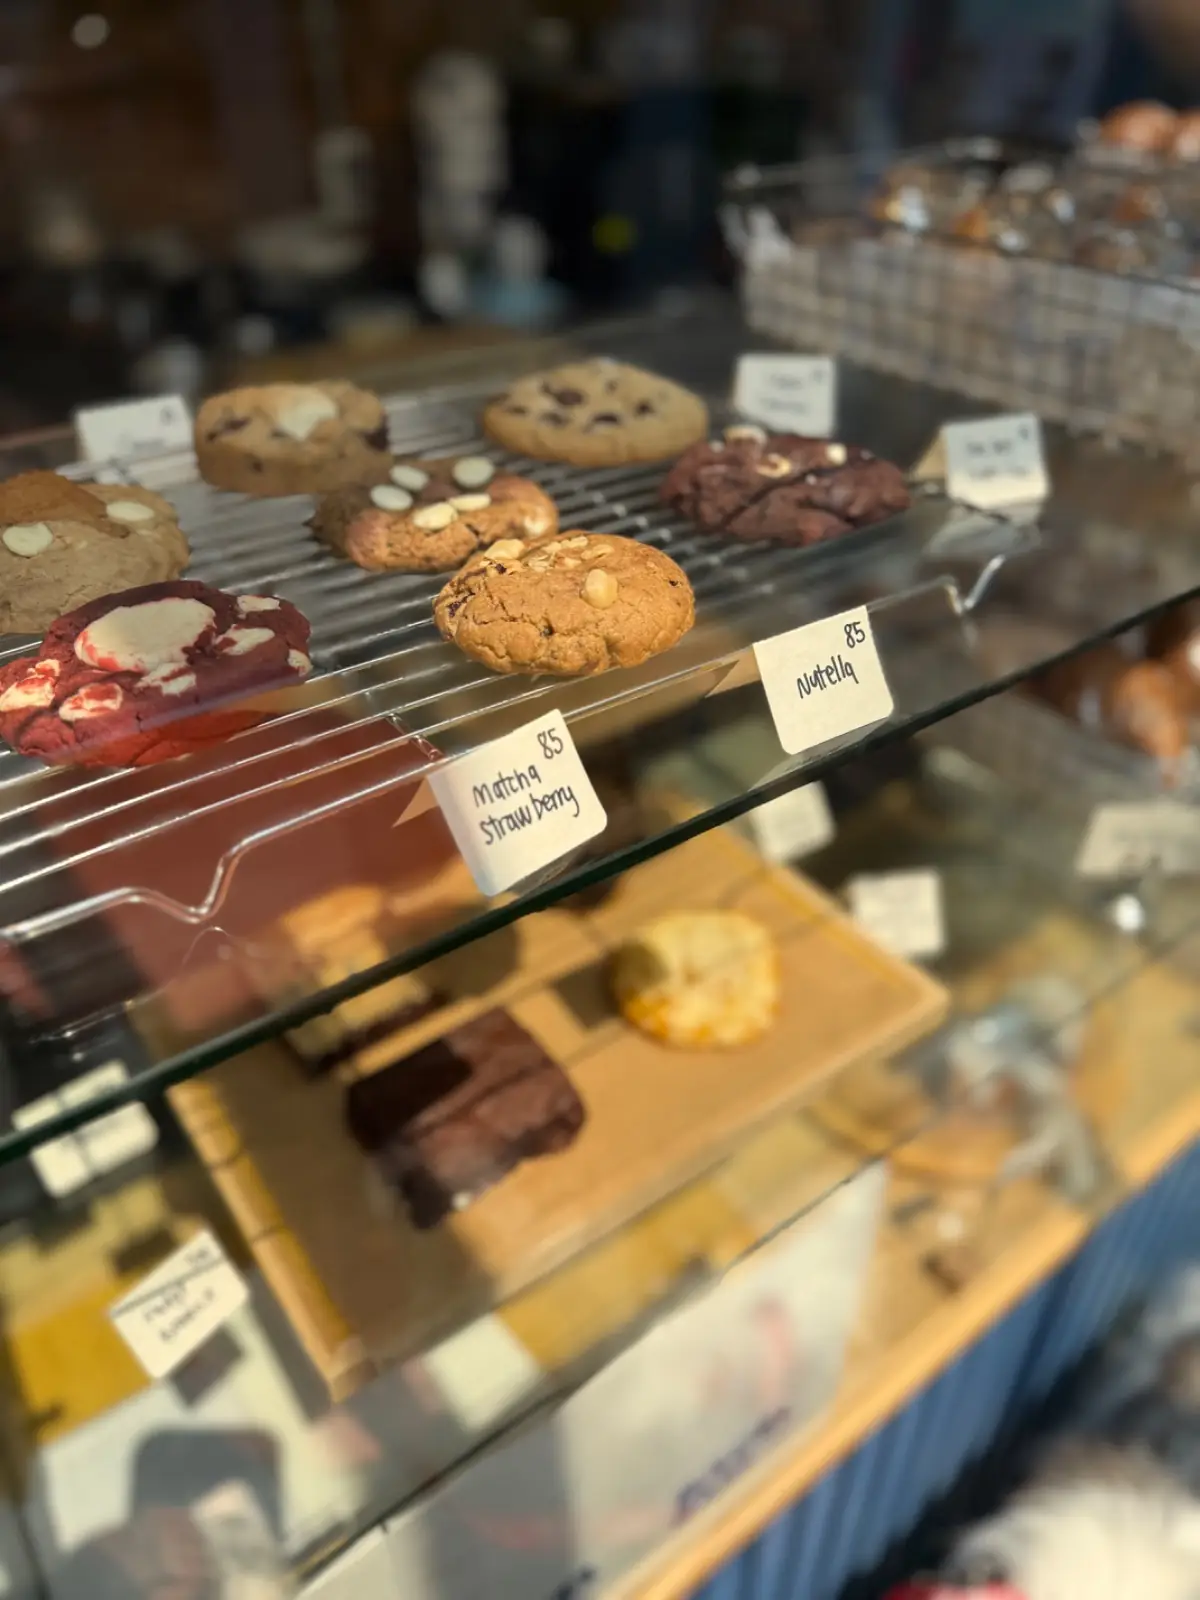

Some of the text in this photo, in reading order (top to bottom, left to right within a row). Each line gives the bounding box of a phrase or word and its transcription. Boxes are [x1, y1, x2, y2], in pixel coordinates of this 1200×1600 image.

[844, 621, 866, 649] 85
[796, 654, 860, 699] Nutella
[536, 727, 564, 760] 85
